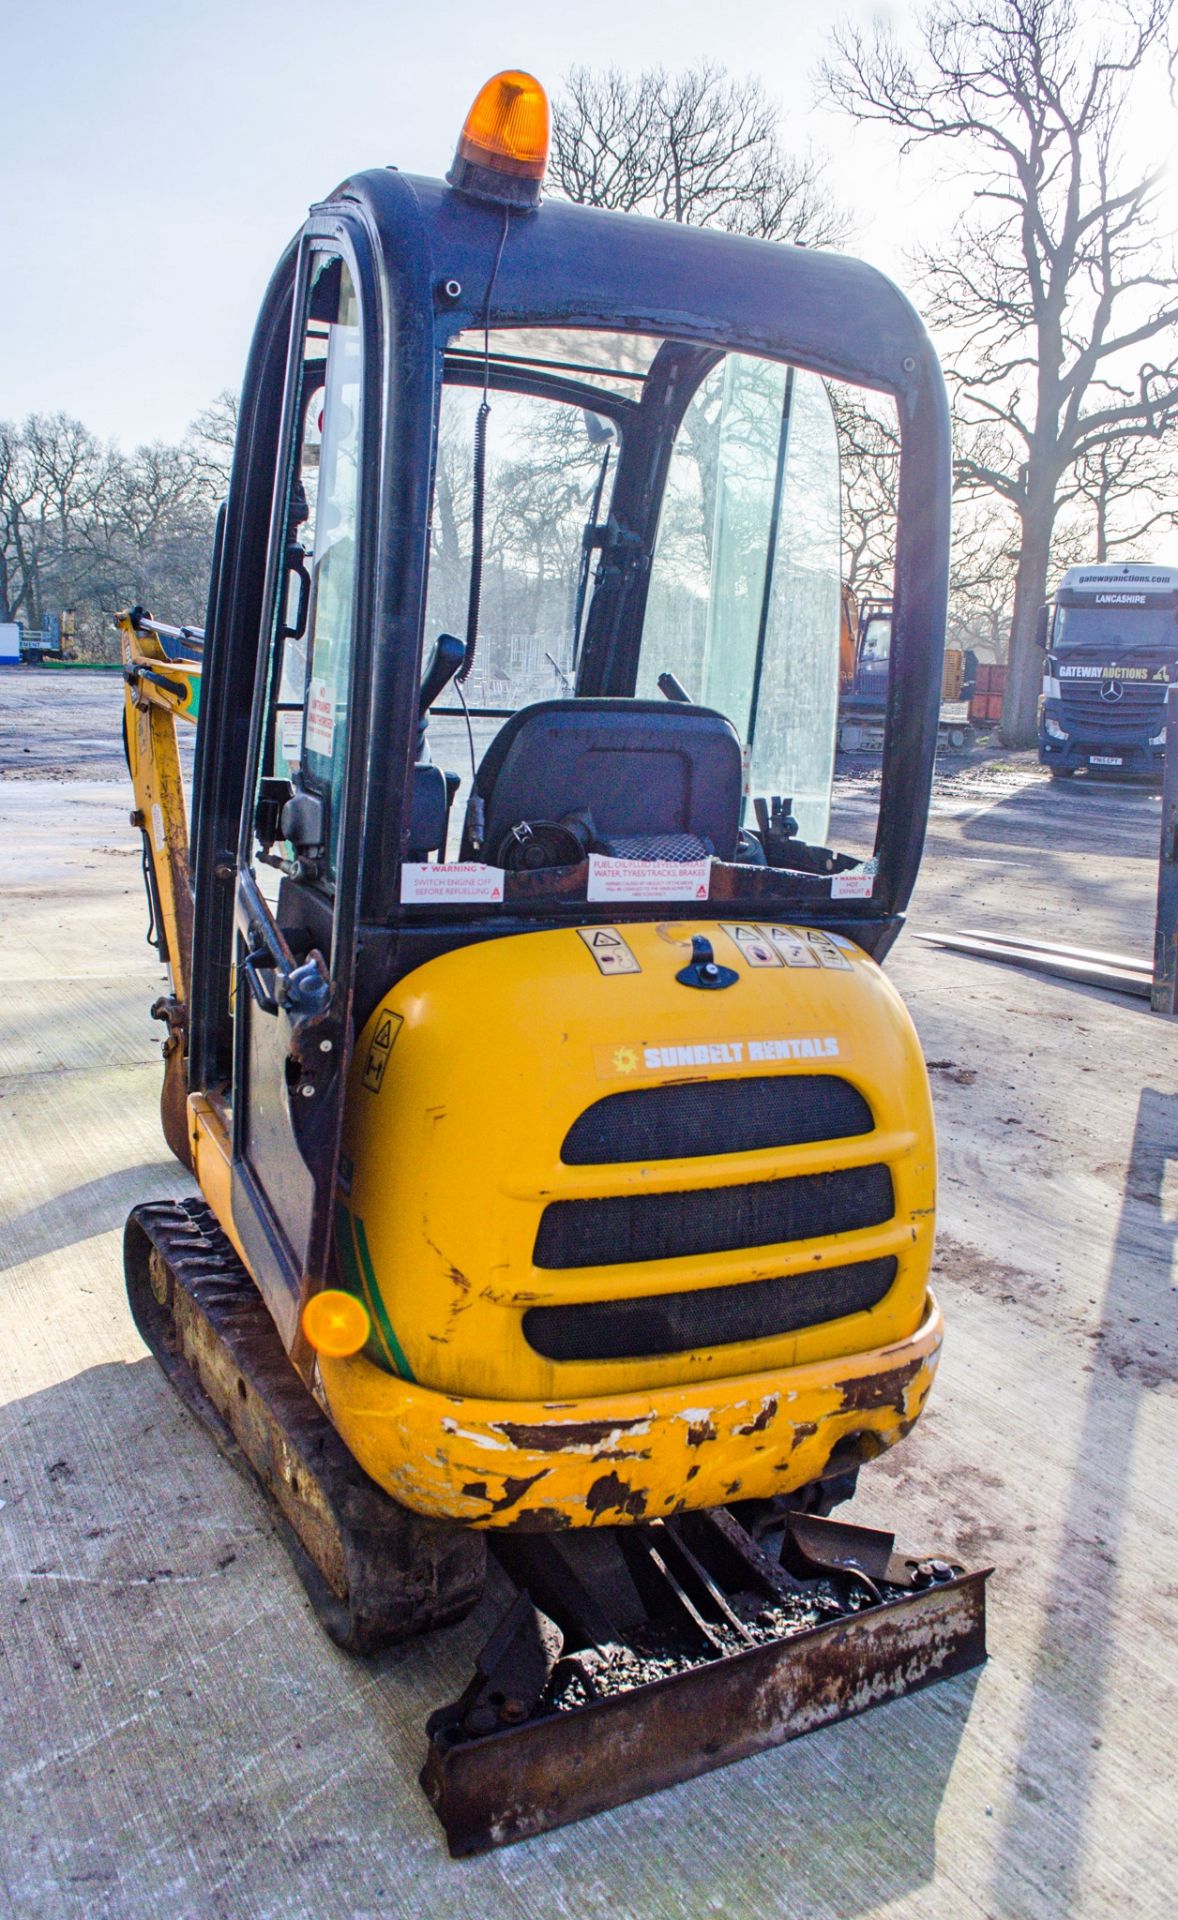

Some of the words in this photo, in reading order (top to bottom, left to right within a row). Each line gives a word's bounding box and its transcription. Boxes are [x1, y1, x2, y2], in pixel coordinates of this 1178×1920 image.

[1079, 575, 1170, 584] gatewayauctions.com
[1095, 594, 1147, 604] LANCASHIRE
[679, 869, 706, 877] BRAKES
[477, 878, 491, 886] OFF
[643, 1042, 743, 1069] SUNBELT
[747, 1037, 840, 1061] RENTALS
